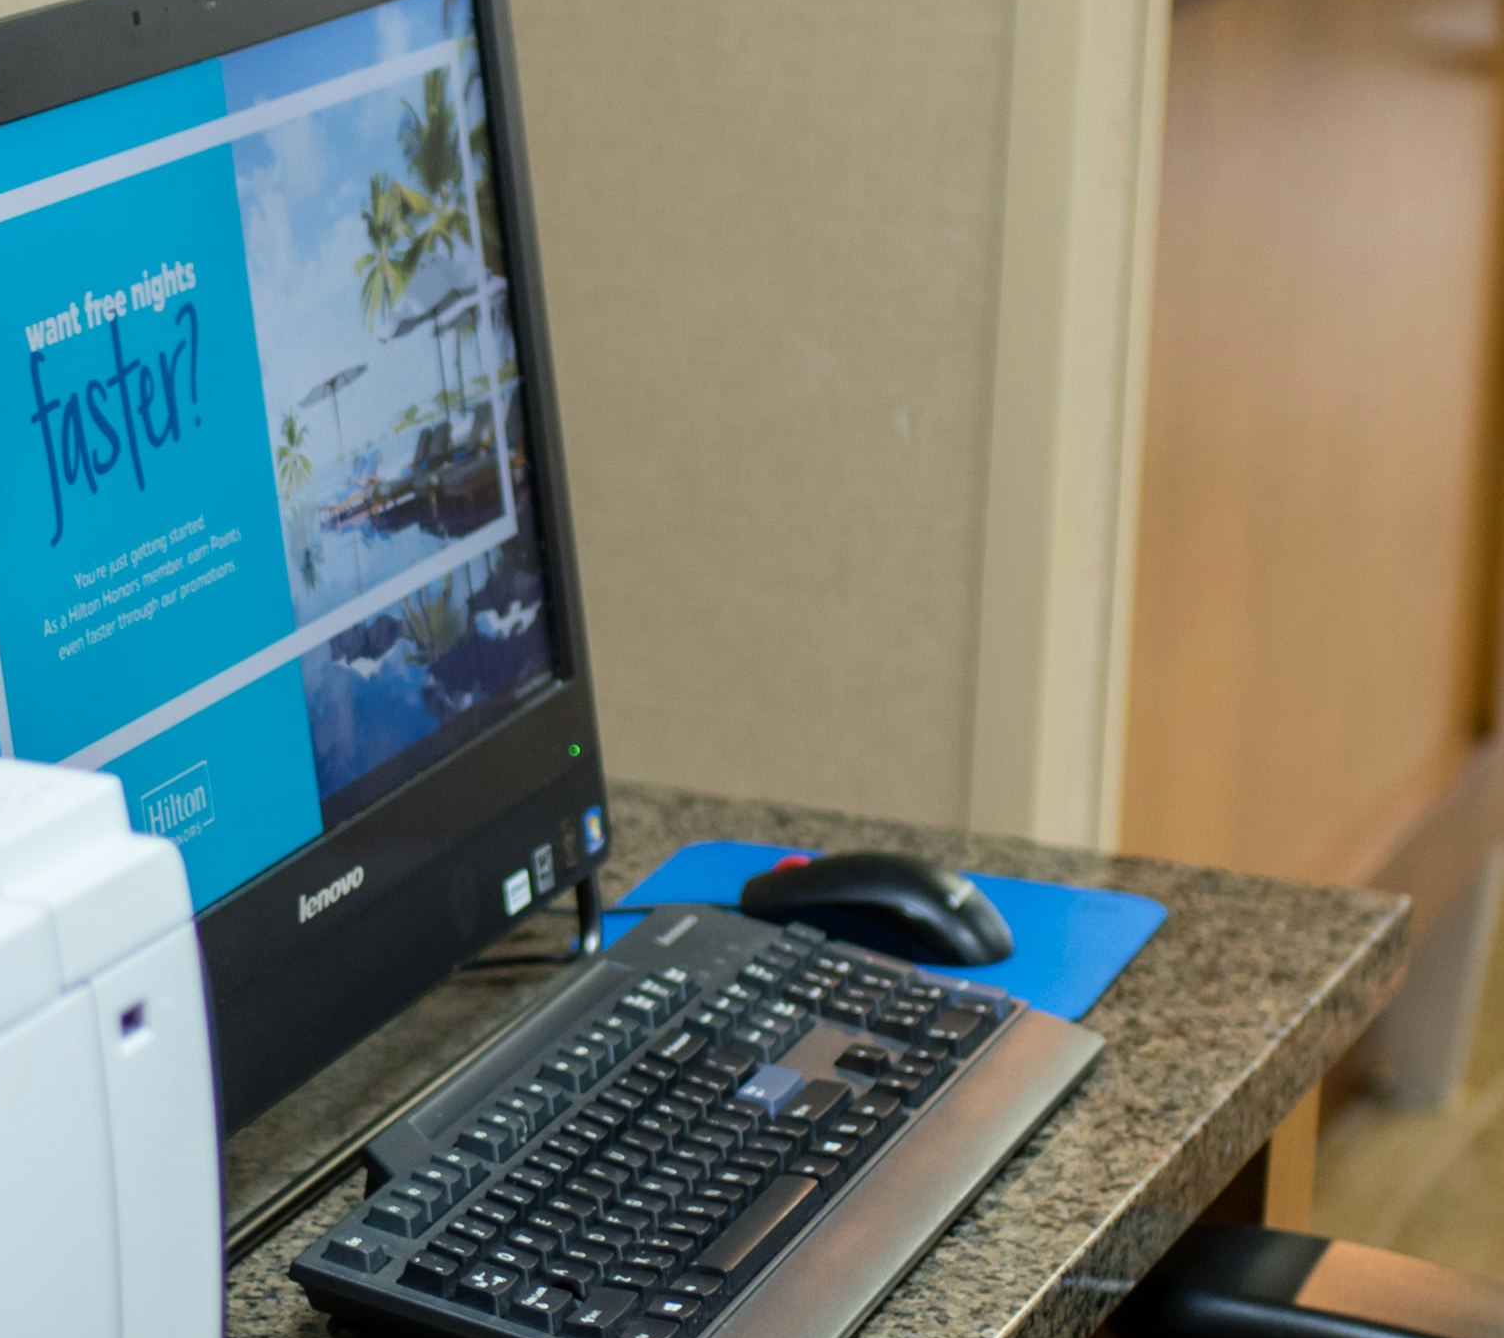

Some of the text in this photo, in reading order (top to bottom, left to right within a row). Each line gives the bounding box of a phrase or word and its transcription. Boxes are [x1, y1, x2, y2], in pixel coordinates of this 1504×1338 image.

[25, 260, 197, 351] want free nights
[31, 301, 201, 547] faster?
[68, 598, 101, 625] Hilton
[148, 784, 208, 836] Hilton
[298, 865, 365, 924] lenovo
